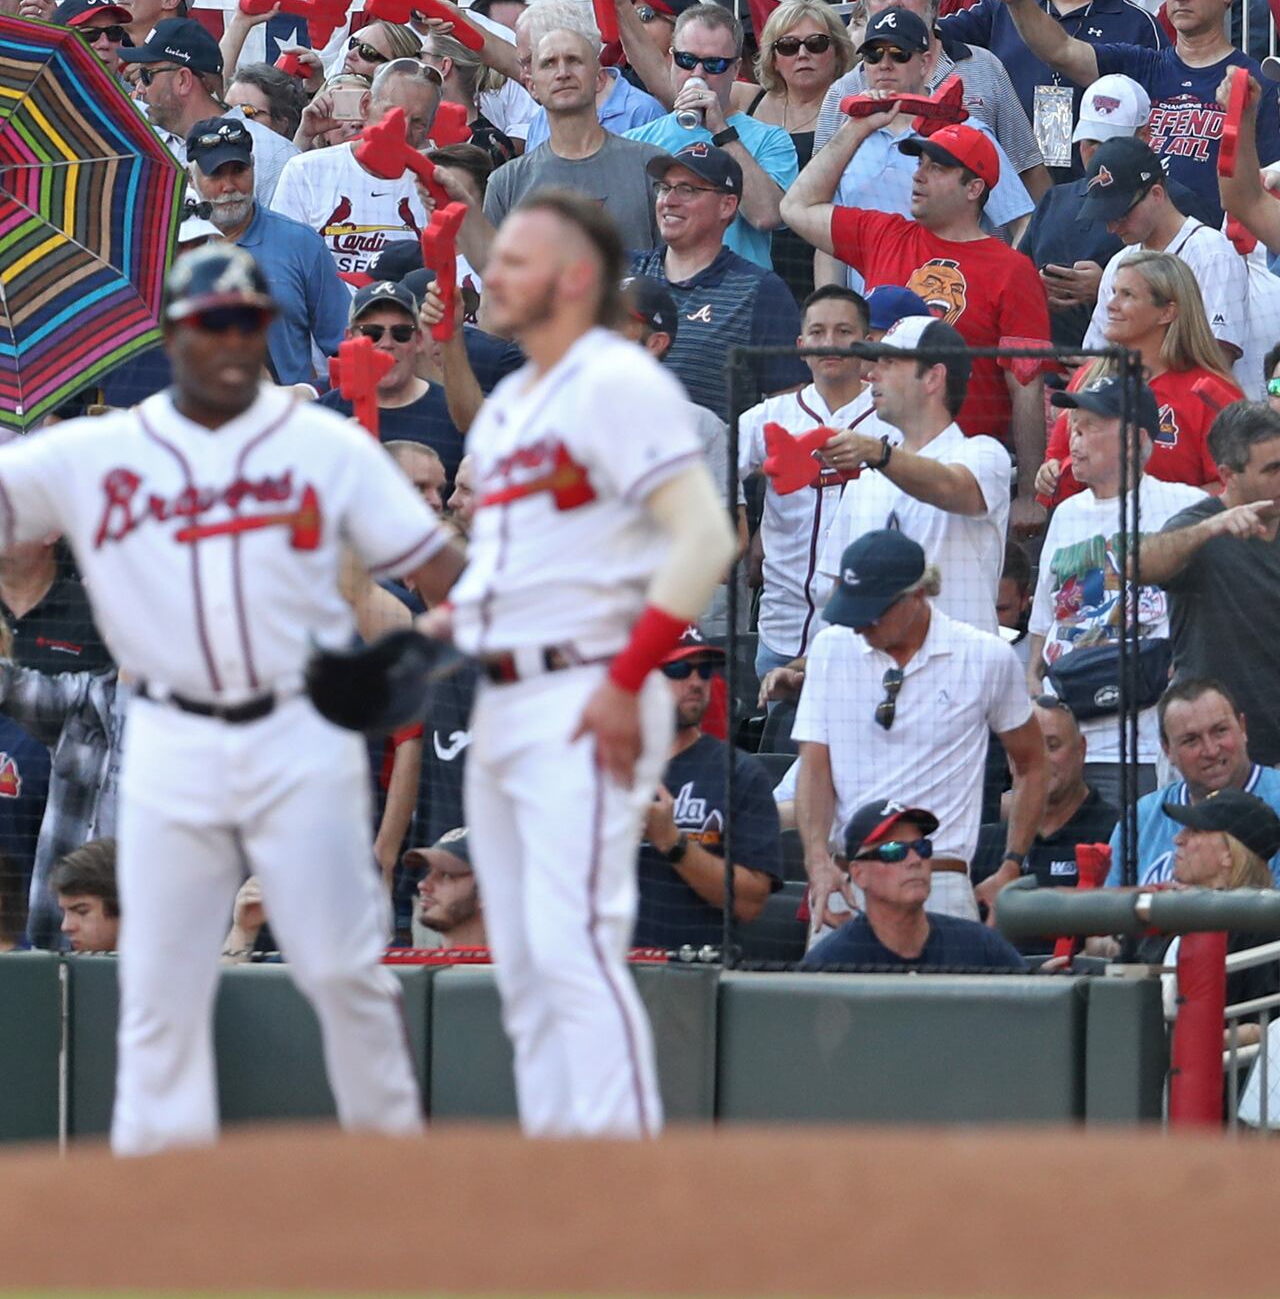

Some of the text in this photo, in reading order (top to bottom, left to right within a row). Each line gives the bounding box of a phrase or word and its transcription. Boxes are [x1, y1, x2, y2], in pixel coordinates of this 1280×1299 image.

[874, 13, 897, 29] A
[1148, 111, 1224, 140] EFEND
[331, 231, 387, 258] Cardi
[686, 304, 711, 323] A
[93, 467, 294, 549] Braves
